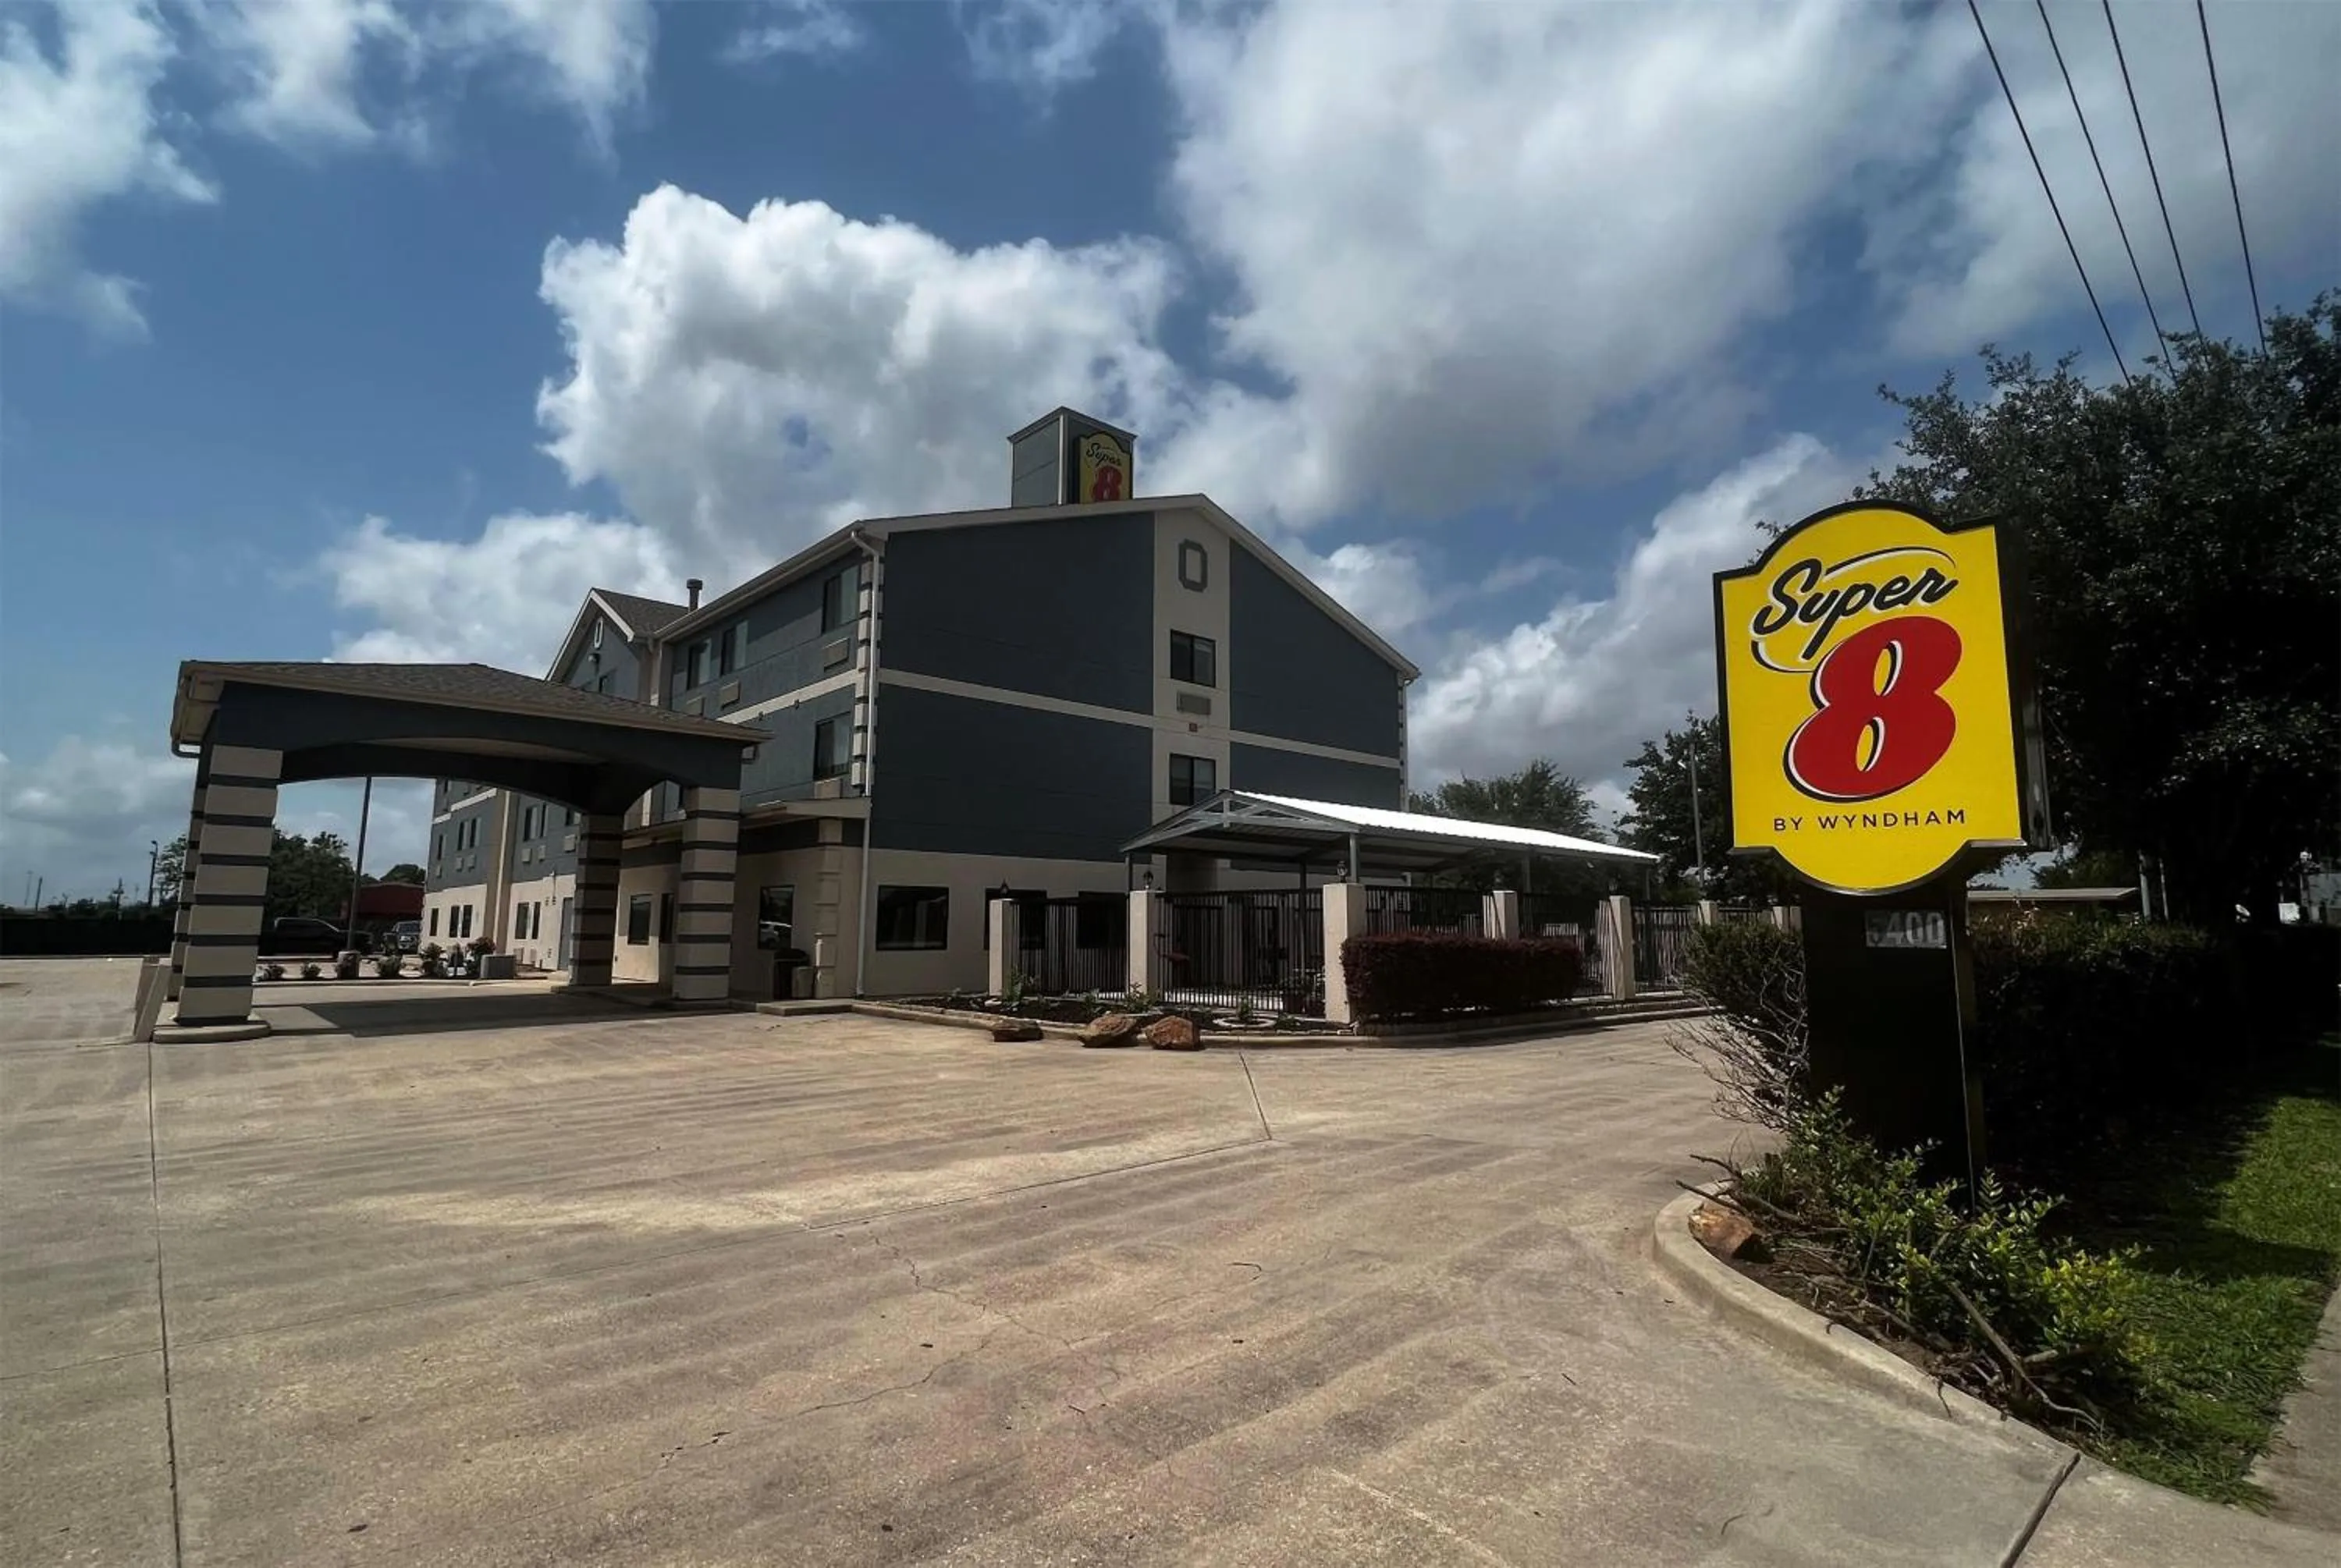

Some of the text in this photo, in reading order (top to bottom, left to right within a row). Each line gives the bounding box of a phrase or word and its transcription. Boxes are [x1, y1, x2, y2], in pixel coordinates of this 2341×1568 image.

[1085, 442, 1122, 467] Super
[1090, 466, 1123, 502] 8
[1753, 558, 1959, 660] Super
[1783, 615, 1963, 804] 8
[1773, 808, 1966, 832] BY WYNDHAM
